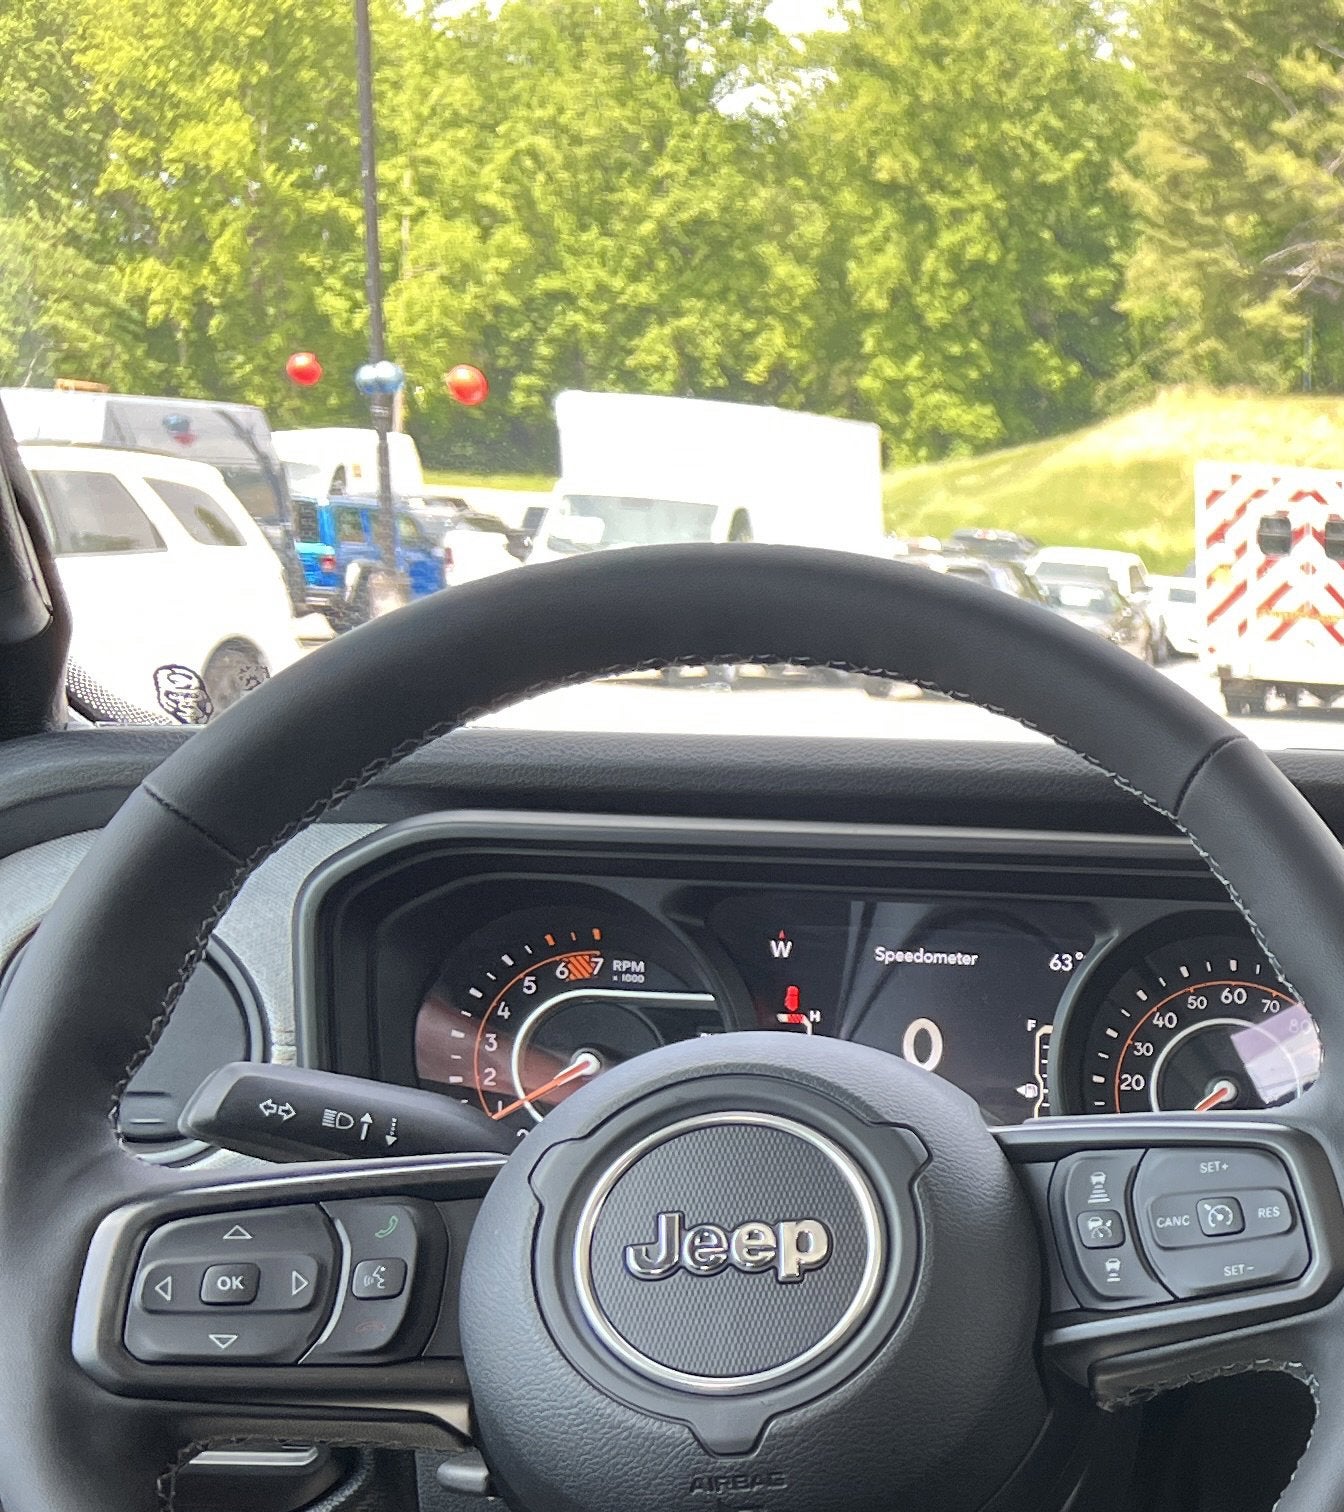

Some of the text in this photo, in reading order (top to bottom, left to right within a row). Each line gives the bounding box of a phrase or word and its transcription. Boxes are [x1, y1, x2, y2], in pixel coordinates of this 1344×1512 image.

[770, 940, 792, 958] W
[874, 946, 978, 968] Speedometer
[555, 962, 568, 979] 6
[591, 958, 603, 975] 7
[612, 960, 645, 973] RPM
[523, 976, 537, 994] 5
[1187, 996, 1208, 1010] 50
[1220, 988, 1247, 1005] 60
[497, 1001, 510, 1019] 4
[1261, 999, 1280, 1014] 70
[810, 1011, 821, 1022] H
[1153, 1012, 1178, 1029] 40
[1027, 1020, 1036, 1032] F
[484, 1034, 498, 1051] 3
[903, 1017, 944, 1072] 0
[1134, 1042, 1154, 1056] 30
[484, 1068, 497, 1086] 2
[1121, 1074, 1144, 1090] 20
[1200, 1161, 1228, 1173] SET+
[1156, 1215, 1190, 1228] CANC
[1258, 1207, 1280, 1219] RES
[624, 1210, 833, 1284] Jeep
[216, 1274, 245, 1292] OK
[689, 1472, 787, 1494] AIRBAG
